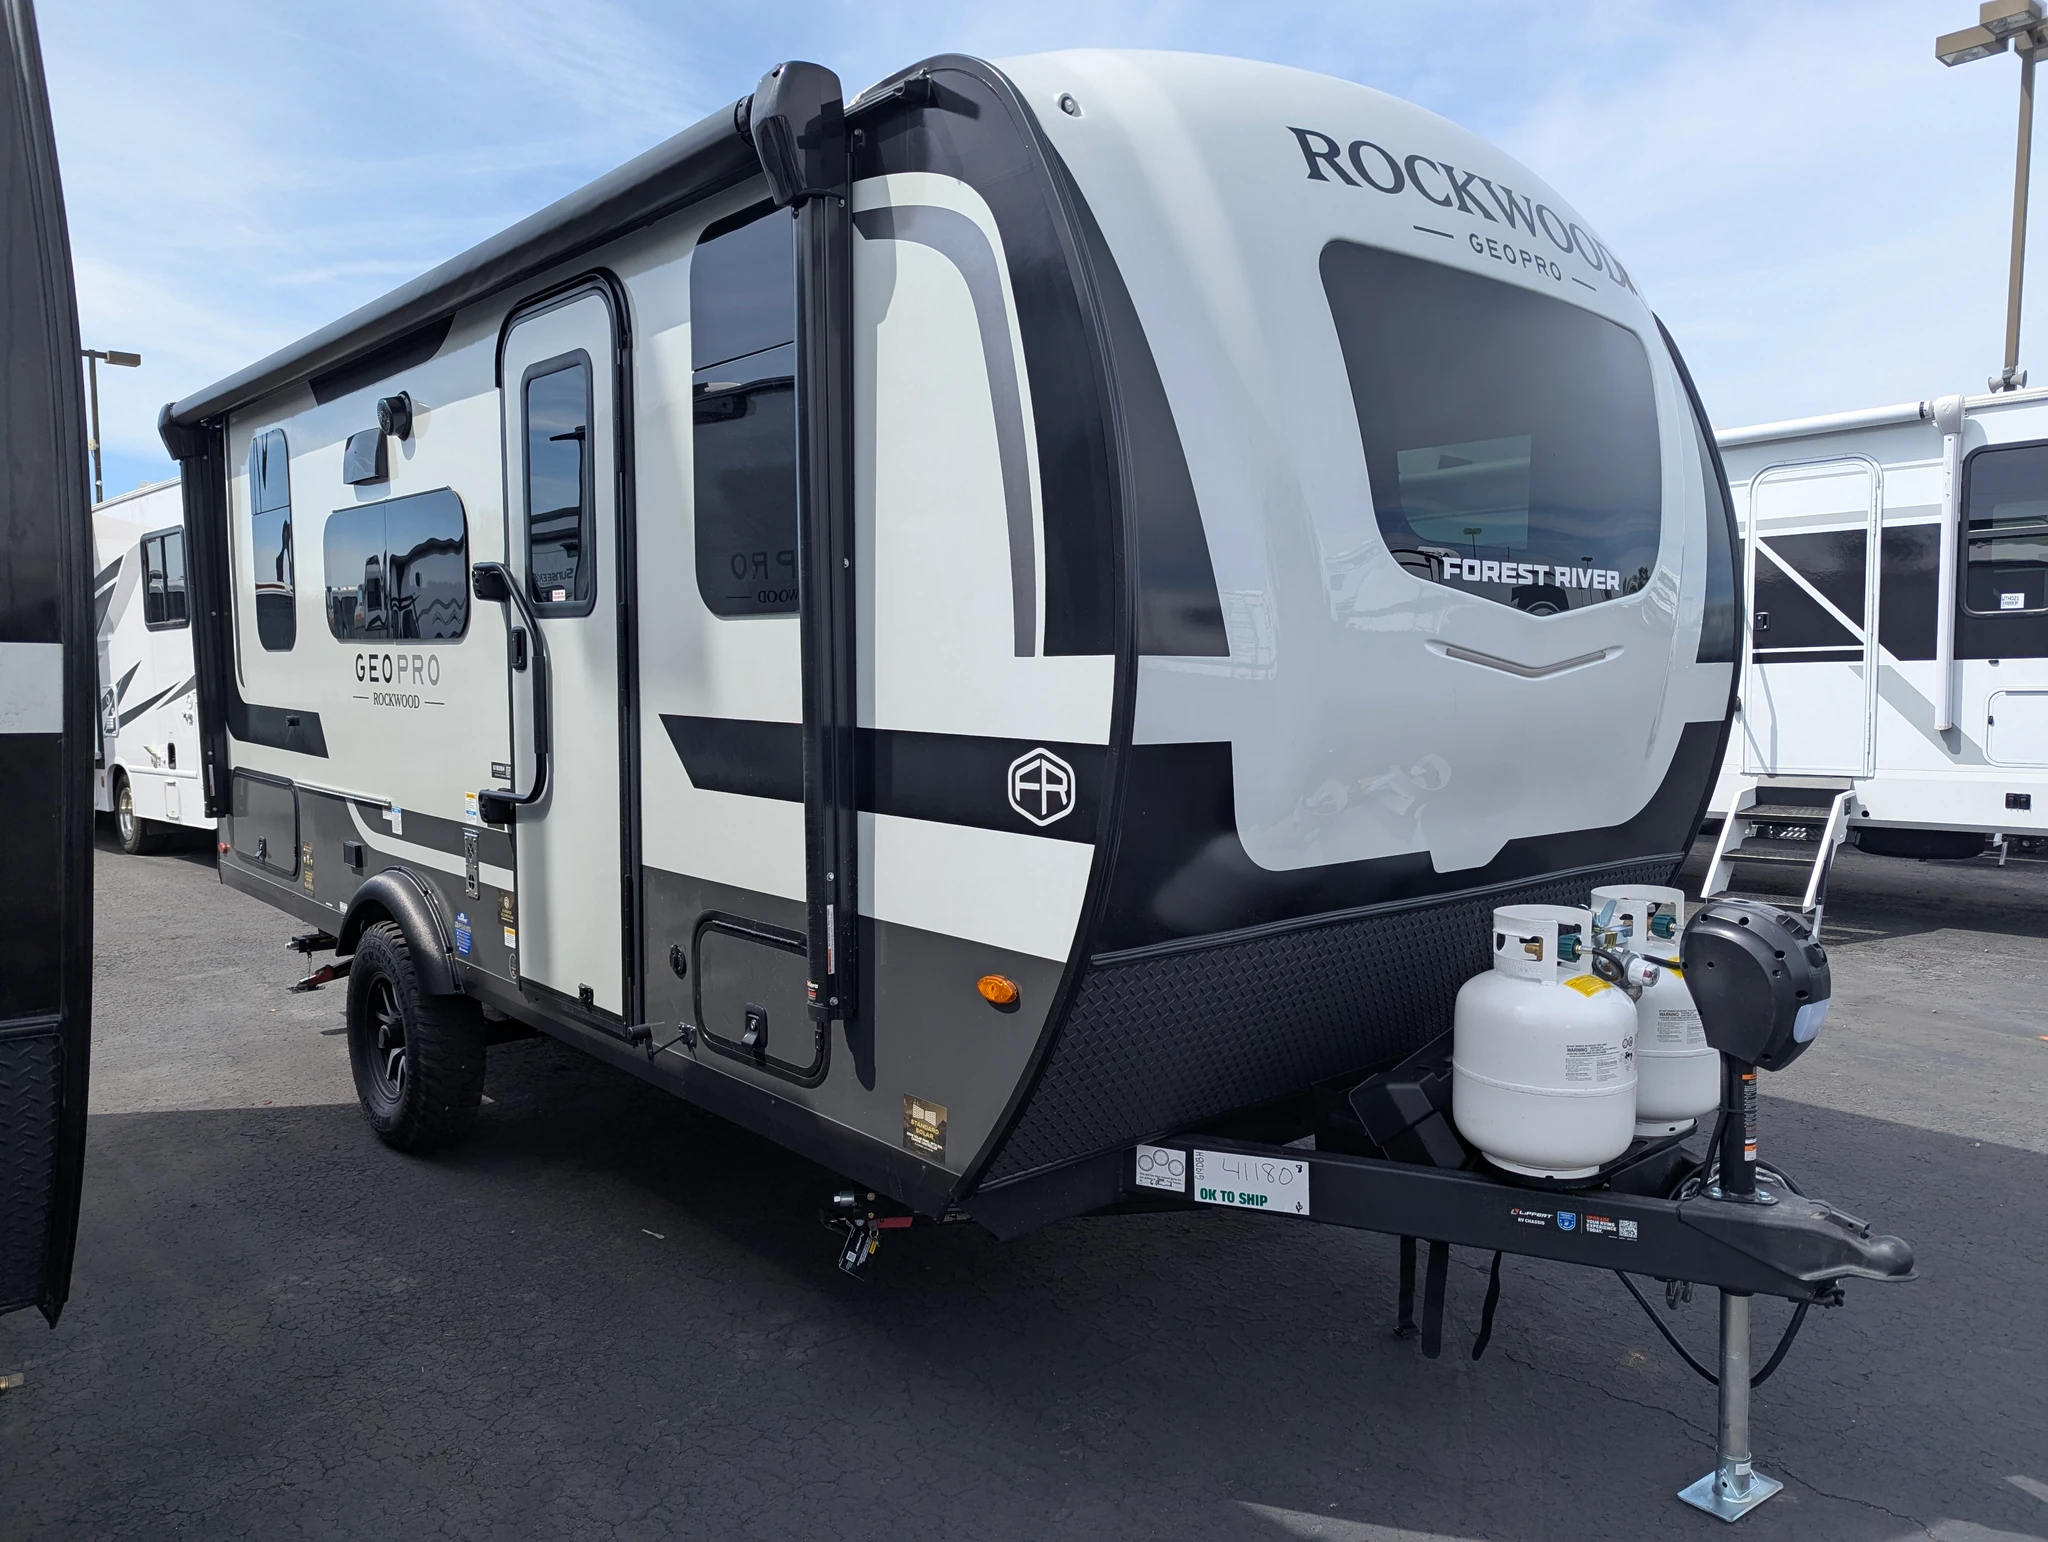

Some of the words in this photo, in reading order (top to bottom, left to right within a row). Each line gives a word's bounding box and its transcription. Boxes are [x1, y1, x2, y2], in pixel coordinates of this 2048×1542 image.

[1286, 126, 1632, 291] ROCKWOOD
[1468, 232, 1562, 282] GEOPRO
[1442, 556, 1550, 586] FOREST
[1554, 566, 1620, 591] RIVER
[355, 653, 440, 686] GEOPRO
[373, 691, 420, 709] ROCKWOOD
[910, 1118, 940, 1135] STANDARD
[915, 1127, 935, 1140] SOLAR
[1222, 1158, 1294, 1186] 41180
[1200, 1187, 1218, 1201] OK
[1220, 1190, 1235, 1204] TO
[1238, 1192, 1268, 1207] SHIP
[1525, 1218, 1546, 1226] CHASSIS
[1586, 1223, 1617, 1232] EXPERIENCE
